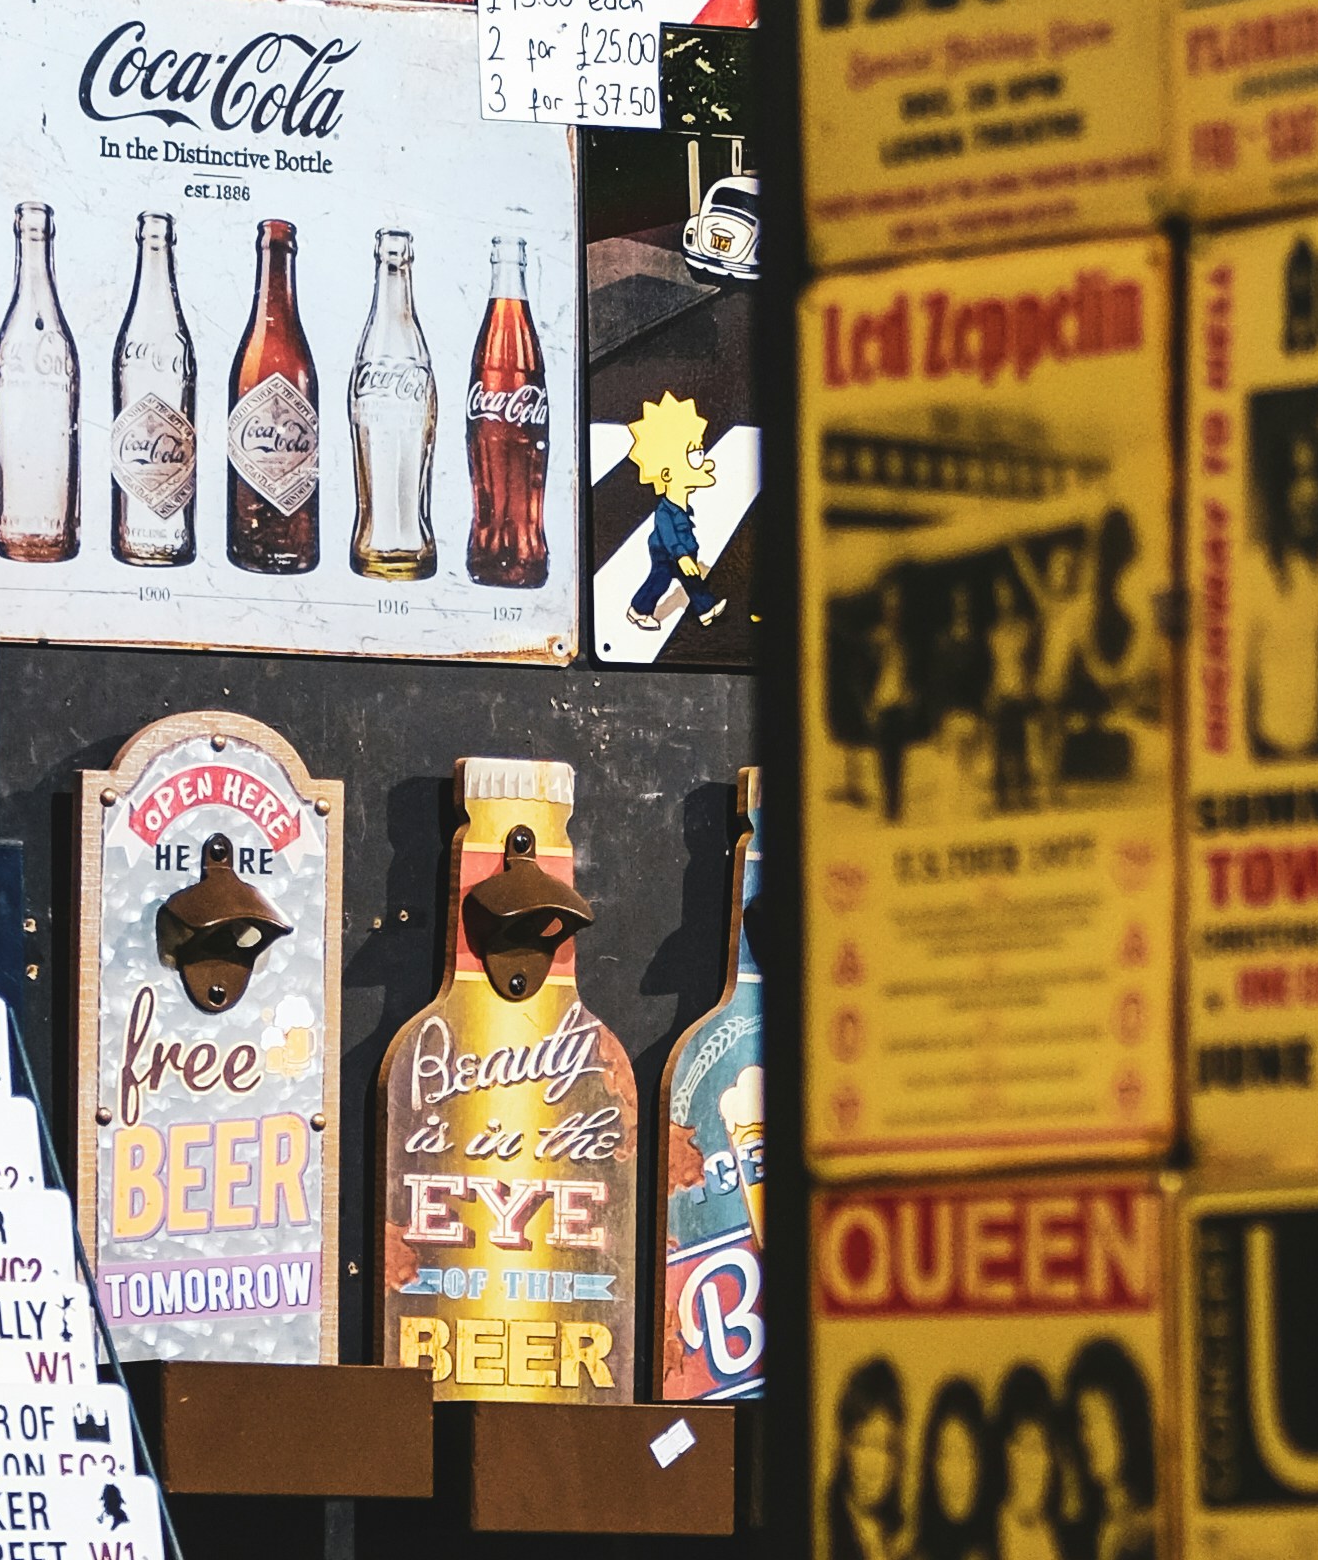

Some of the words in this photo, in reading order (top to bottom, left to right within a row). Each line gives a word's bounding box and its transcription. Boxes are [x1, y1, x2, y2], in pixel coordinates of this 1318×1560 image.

[488, 26, 505, 60] 2
[527, 38, 556, 72] for
[577, 22, 656, 70] £25.00
[78, 20, 362, 139] Coca-Cola
[488, 73, 506, 112] 3
[528, 77, 563, 122] for
[575, 76, 655, 118] £37.50
[100, 136, 121, 158] In
[126, 138, 158, 161] the
[163, 141, 270, 169] Distinctive
[275, 149, 333, 173] Bottle
[821, 294, 911, 389] Led
[921, 266, 1144, 388] Zeppelin
[466, 381, 548, 426] Coca-Cola
[137, 587, 170, 601] 1900
[377, 600, 408, 615] 1916
[492, 607, 522, 620] 1957
[145, 773, 212, 830] OPEN
[223, 774, 291, 839] HERE
[120, 984, 263, 1130] free
[412, 1004, 601, 1112] Beauty
[112, 1112, 310, 1241] BEER
[403, 1174, 608, 1249] EYE
[819, 1196, 1157, 1311] QUEEN
[105, 1262, 313, 1318] TOMORROW
